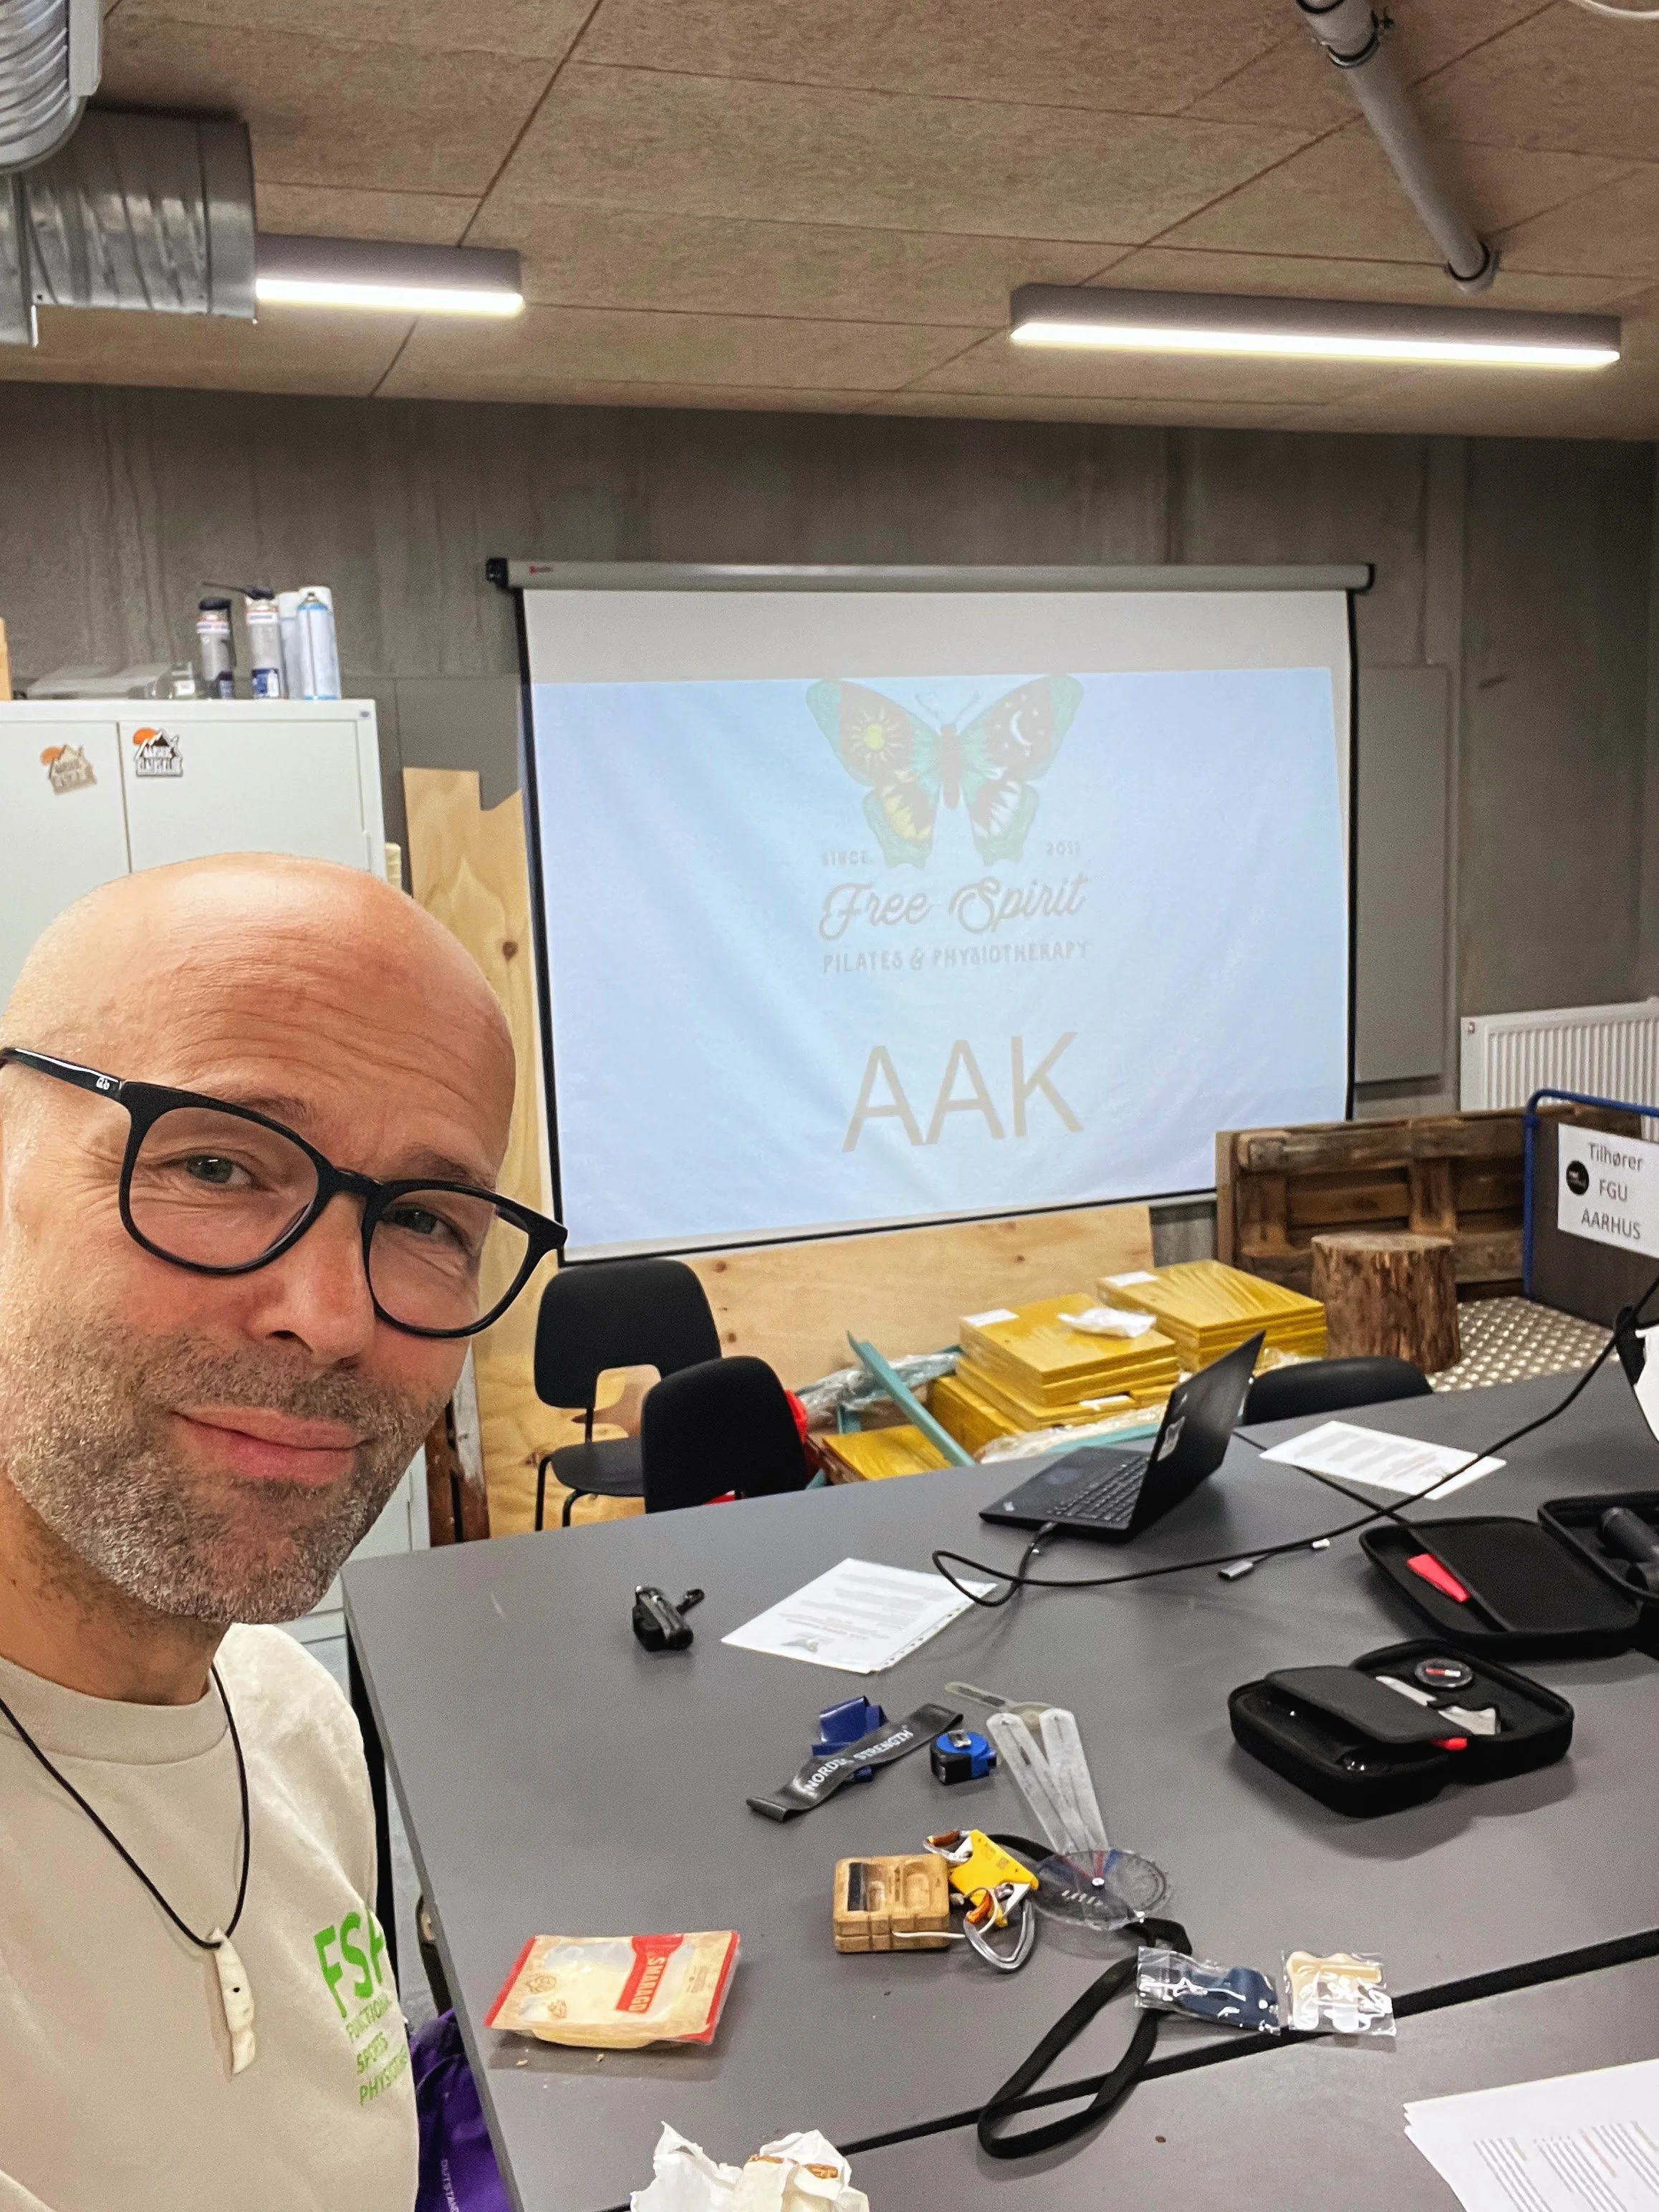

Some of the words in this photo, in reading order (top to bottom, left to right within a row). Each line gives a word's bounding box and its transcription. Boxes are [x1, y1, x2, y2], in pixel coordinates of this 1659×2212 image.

[819, 882, 931, 941] Free
[948, 872, 1089, 933] Spirit
[823, 951, 903, 973] PILATES
[910, 947, 925, 971] &
[933, 941, 1089, 968] PHYSIOTHERAPY
[842, 1032, 1084, 1153] AAK
[1587, 1142, 1644, 1172] Tilhører
[1599, 1179, 1628, 1203] FGU
[1581, 1208, 1641, 1241] AARHUS
[854, 1728, 914, 1760] STRENGTH
